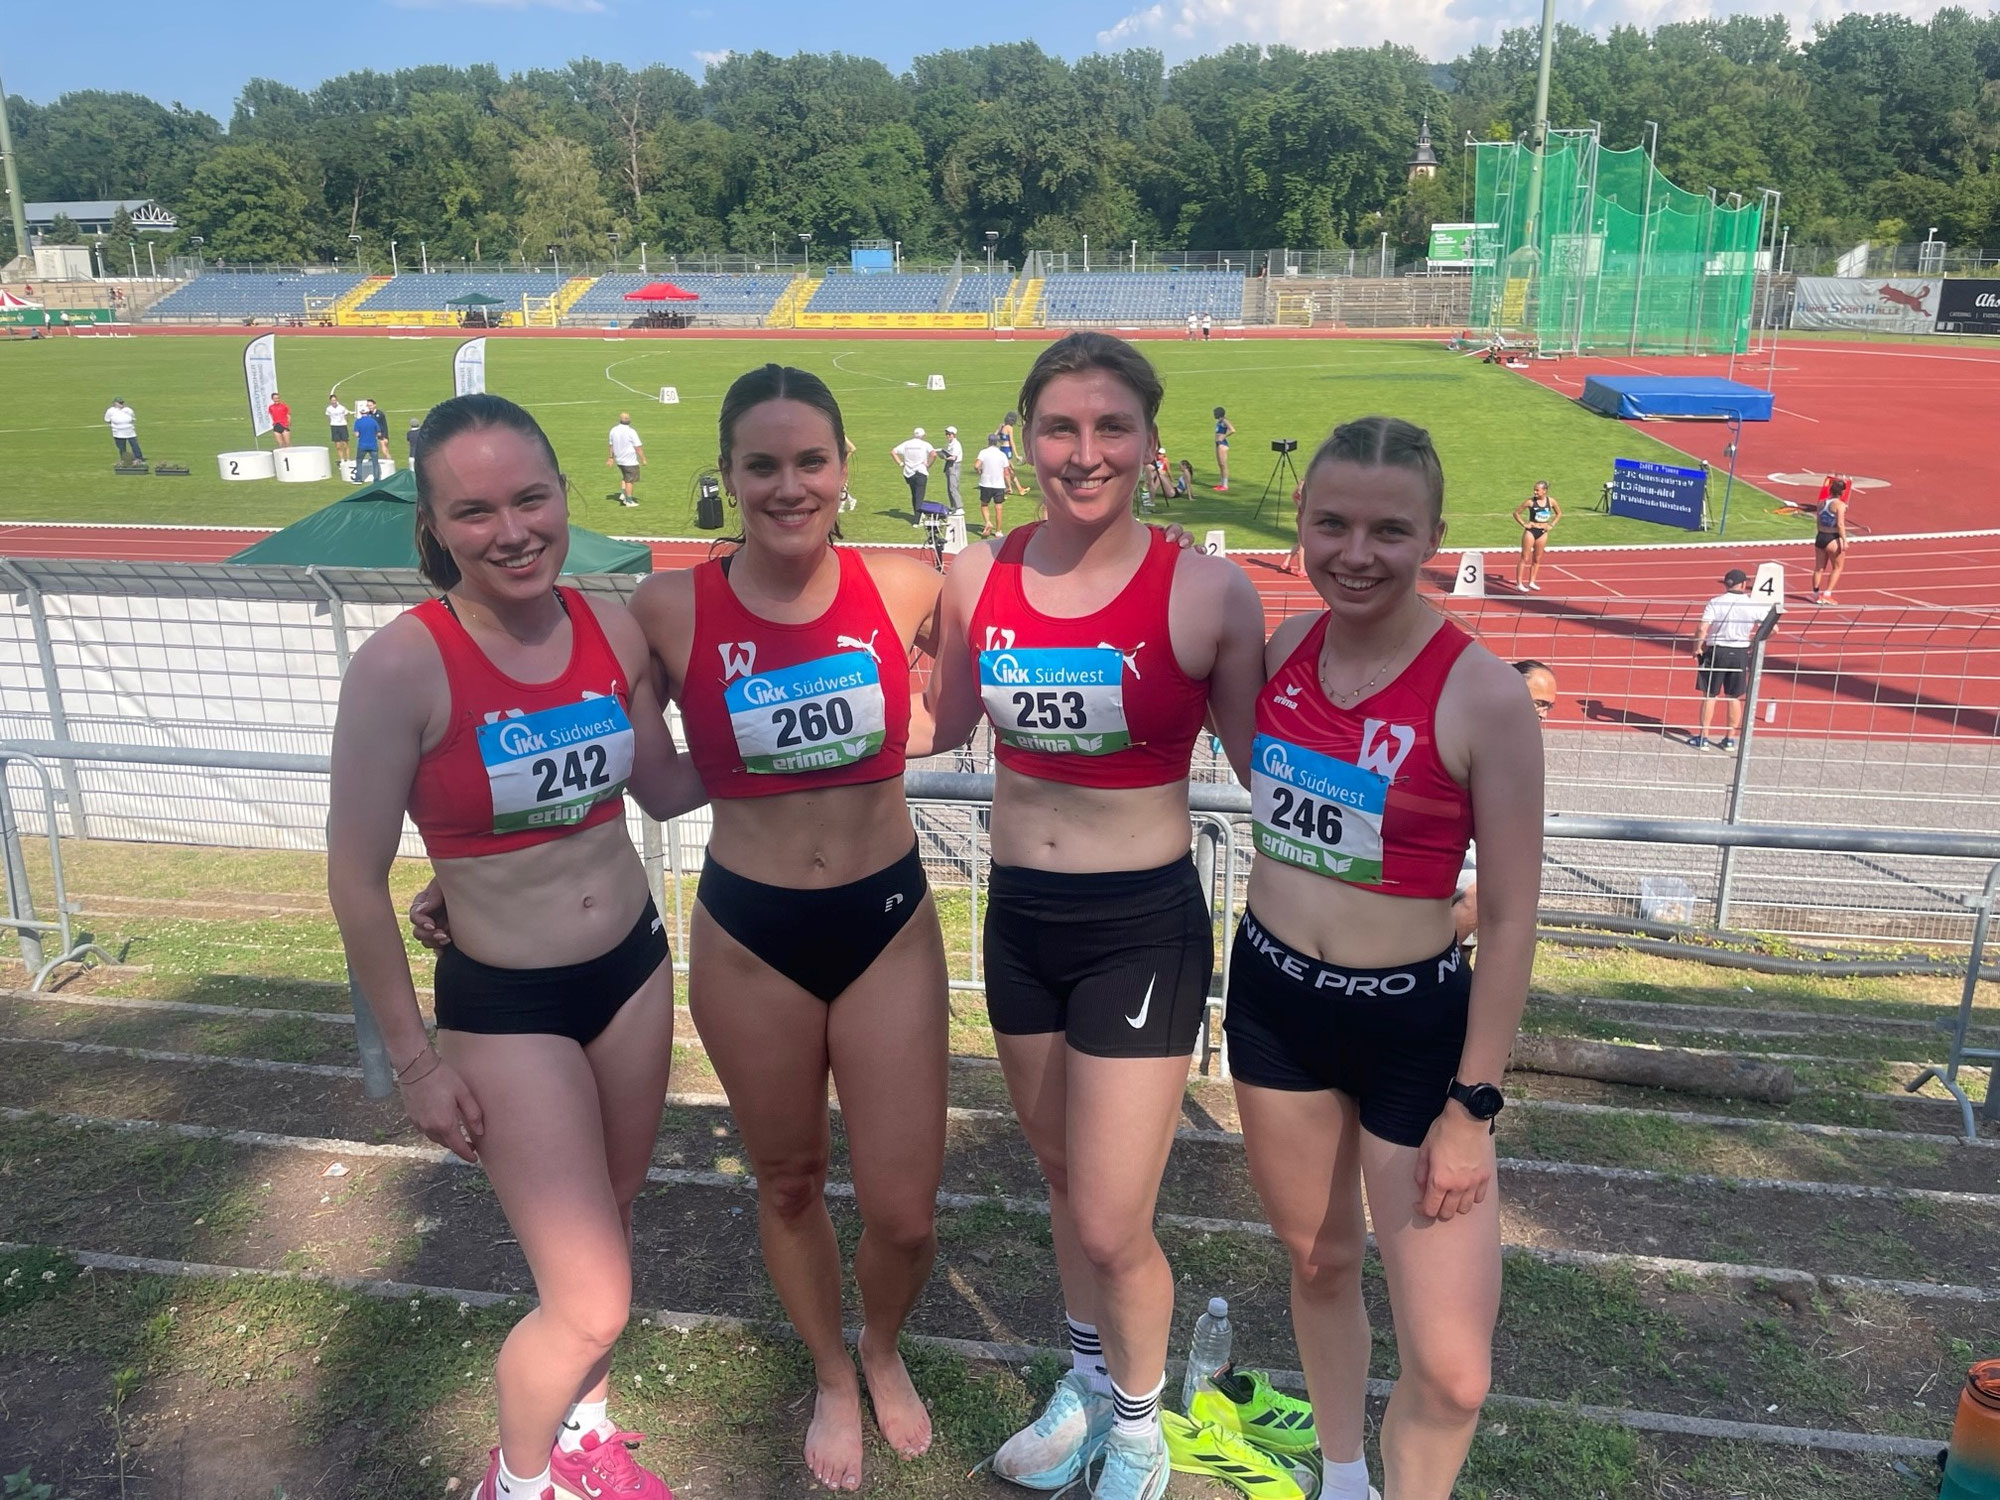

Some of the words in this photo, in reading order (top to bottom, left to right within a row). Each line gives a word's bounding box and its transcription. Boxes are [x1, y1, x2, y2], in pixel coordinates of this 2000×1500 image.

[229, 461, 240, 476] 2
[284, 457, 290, 472] 1
[950, 527, 955, 542] 1
[1463, 565, 1477, 584] 3
[1759, 577, 1774, 596] 4
[793, 671, 864, 697] Südwest
[1035, 668, 1104, 683] Südwest
[1012, 691, 1087, 730] 253
[1273, 694, 1298, 710] erima
[550, 718, 617, 746] Südwest
[771, 697, 854, 749] 260
[1016, 735, 1072, 752] erima
[772, 748, 840, 771] erima
[532, 744, 610, 802] 242
[1298, 770, 1366, 807] Südwest
[1270, 787, 1343, 845] 246
[1261, 832, 1318, 868] erima
[1242, 912, 1310, 981] NIKE
[1314, 969, 1416, 997] PRO
